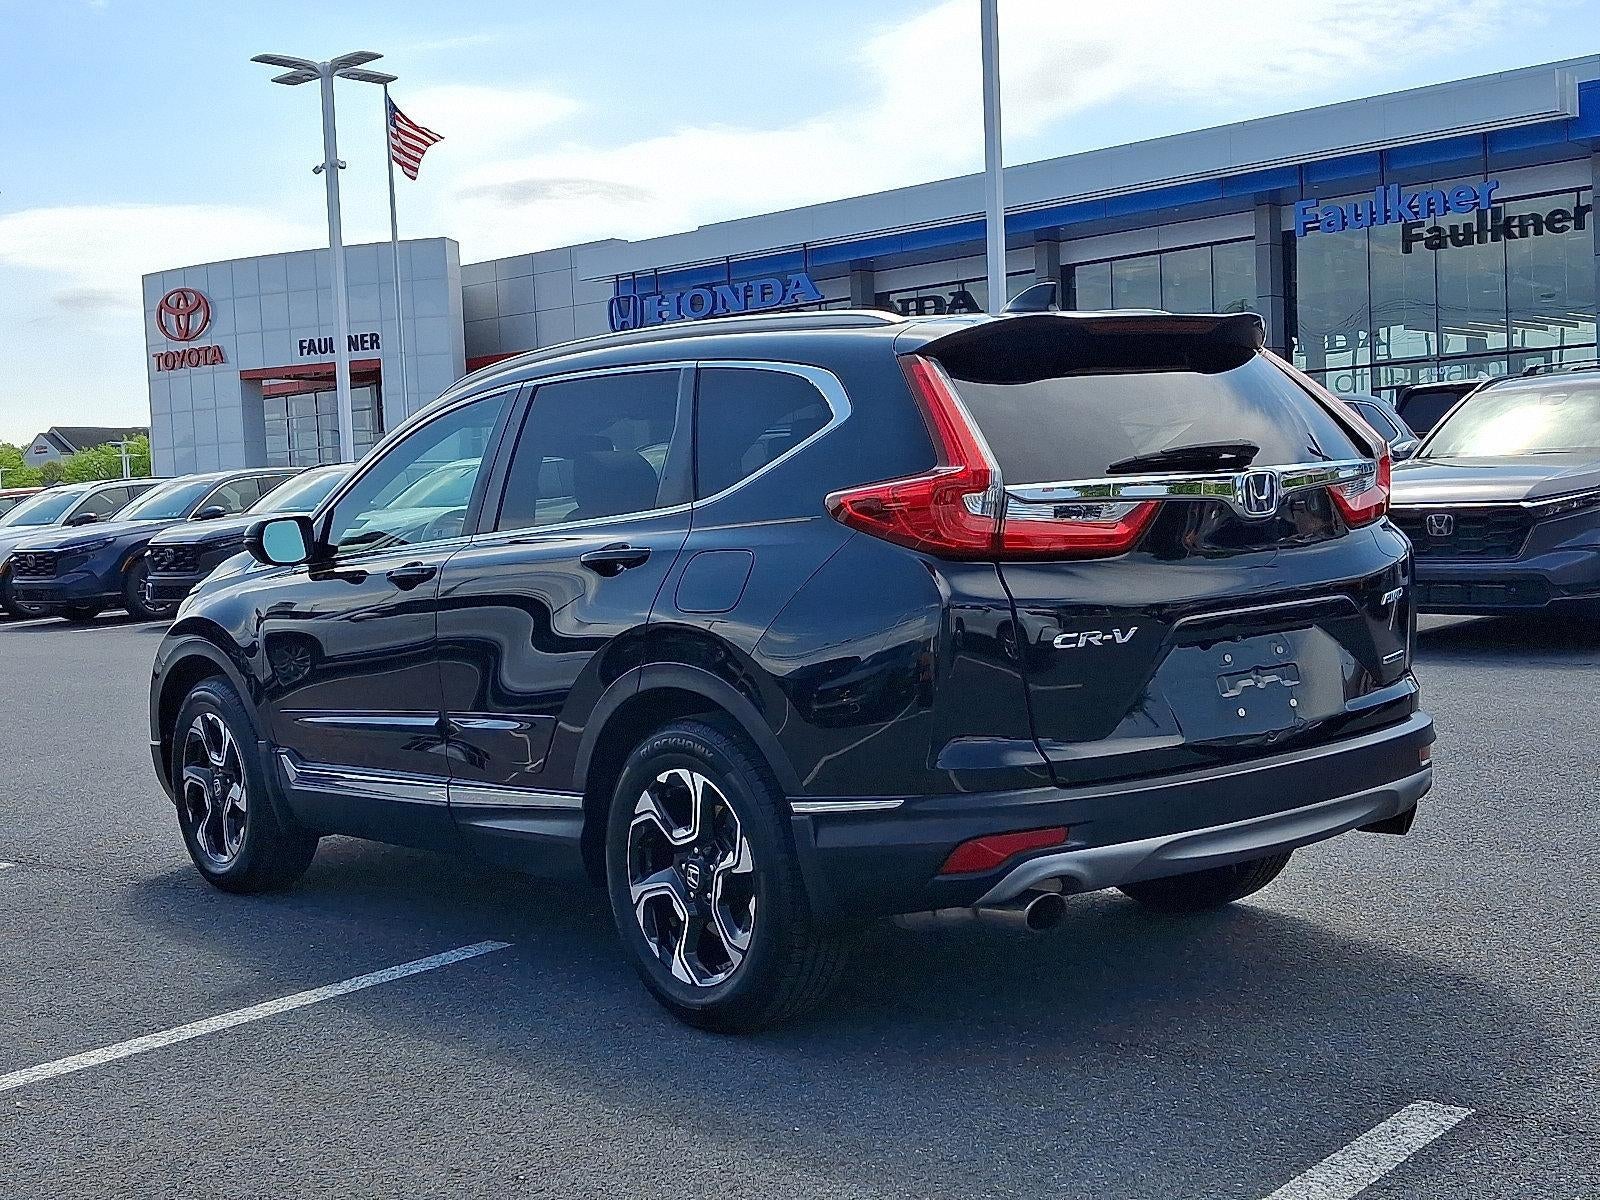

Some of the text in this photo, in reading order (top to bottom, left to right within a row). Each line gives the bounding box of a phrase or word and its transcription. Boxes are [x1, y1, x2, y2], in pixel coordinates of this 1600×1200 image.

[1294, 180, 1500, 238] Faulkner
[1400, 203, 1594, 255] Faulkner
[643, 272, 825, 325] HONDA
[152, 344, 225, 372] TOYOTA
[298, 332, 381, 356] FAULNER
[1053, 625, 1139, 650] CR-V
